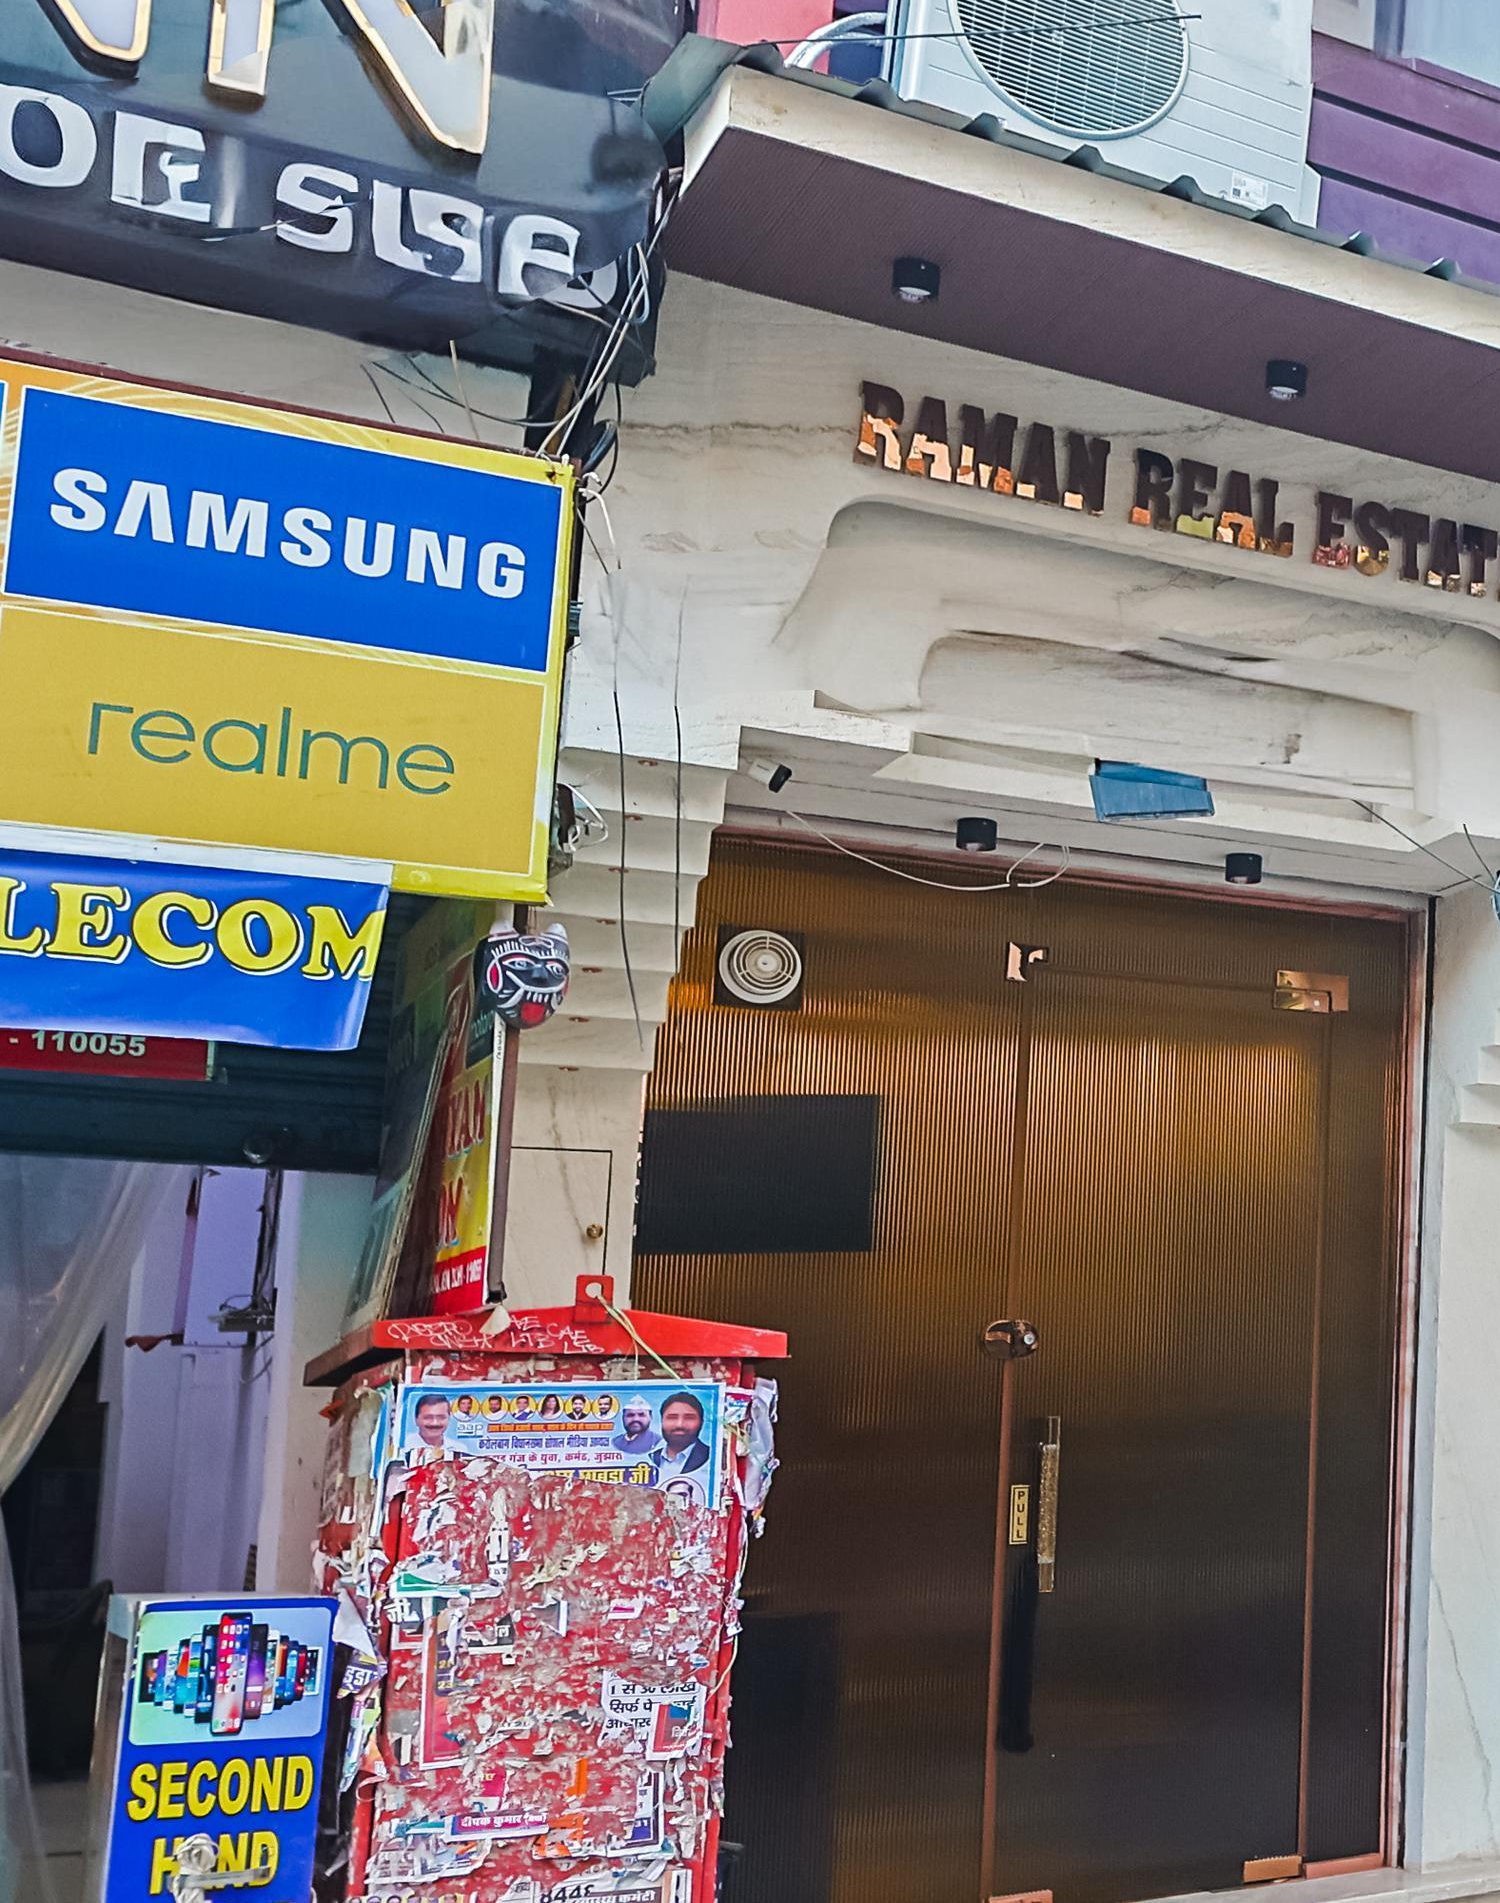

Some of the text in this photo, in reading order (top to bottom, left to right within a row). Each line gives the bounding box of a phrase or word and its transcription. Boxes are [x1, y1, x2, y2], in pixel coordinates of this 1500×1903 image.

[853, 380, 1111, 515] RAMAN
[1129, 447, 1295, 557] REAL
[49, 467, 527, 600] SAMSUNG
[87, 701, 456, 796] realme
[31, 1029, 147, 1058] 110055
[126, 1754, 315, 1822] SECOND
[150, 1829, 280, 1895] HND
